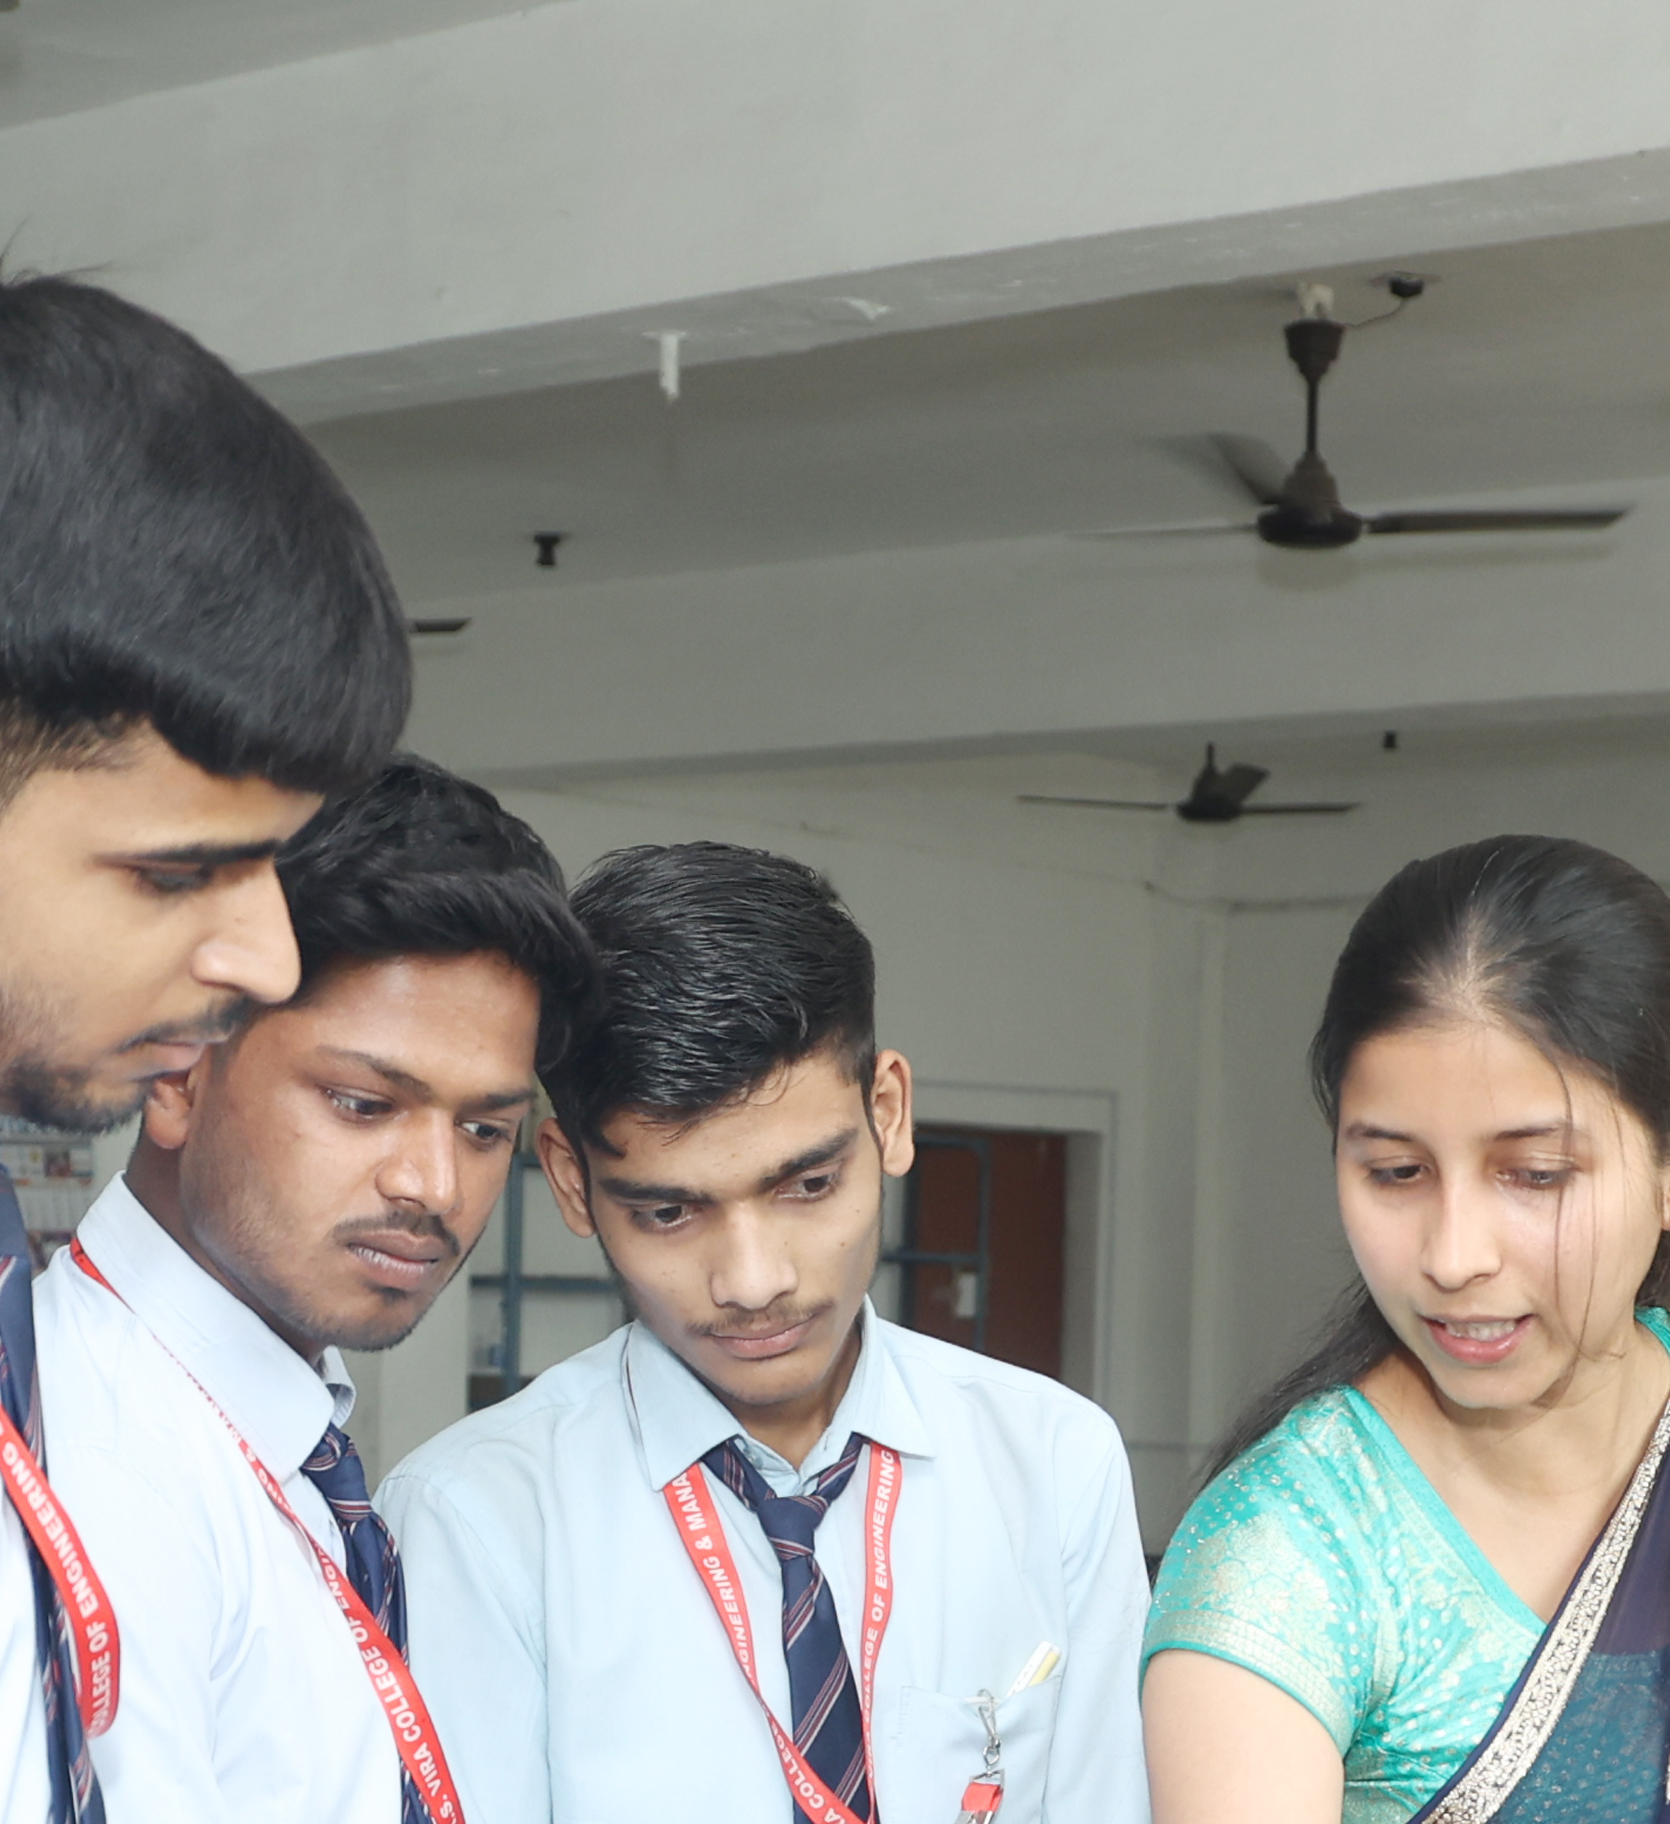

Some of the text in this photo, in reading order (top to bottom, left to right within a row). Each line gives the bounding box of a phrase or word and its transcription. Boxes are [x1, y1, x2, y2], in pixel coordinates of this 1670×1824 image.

[2, 1441, 100, 1619] ENGINEERING
[694, 1535, 713, 1551] &
[872, 1449, 895, 1590] ENGINEERING
[86, 1621, 109, 1653] OF
[348, 1616, 370, 1644] OF
[703, 1556, 753, 1684] NGINEERING
[871, 1592, 886, 1622] OF
[88, 1651, 111, 1737] OLLEGE
[361, 1645, 422, 1743] COLLEGE
[413, 1742, 442, 1797] VIRA
